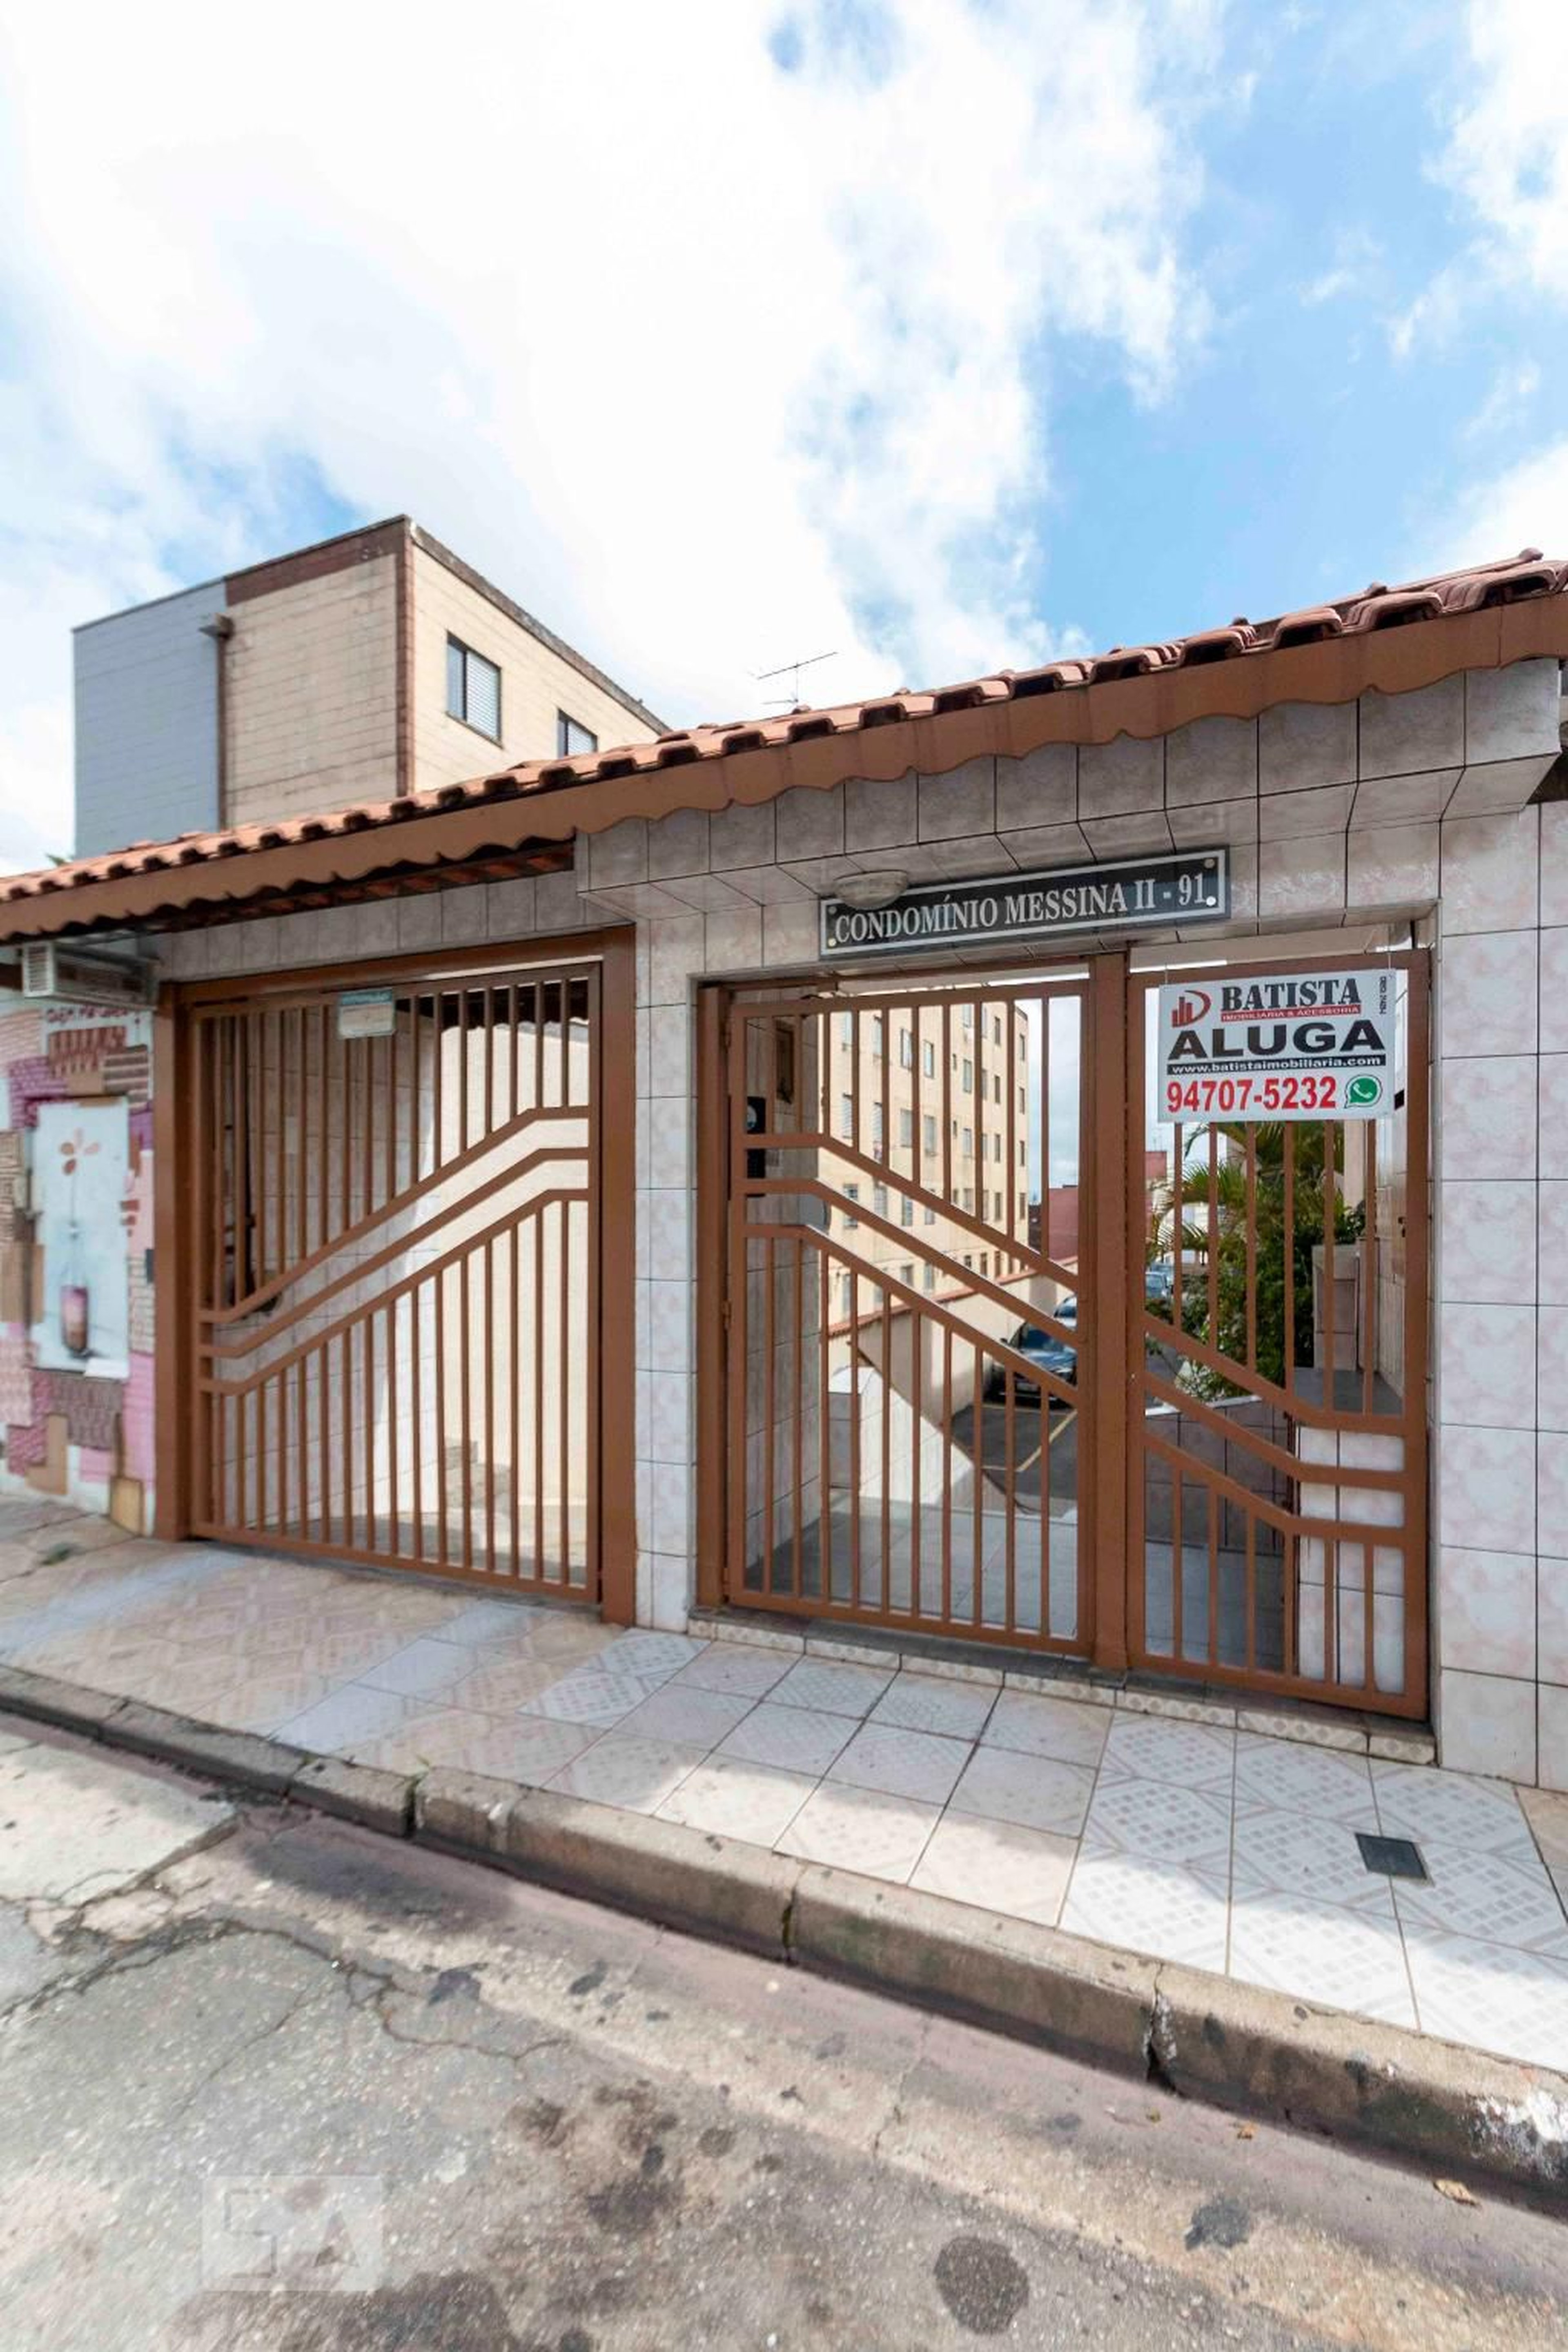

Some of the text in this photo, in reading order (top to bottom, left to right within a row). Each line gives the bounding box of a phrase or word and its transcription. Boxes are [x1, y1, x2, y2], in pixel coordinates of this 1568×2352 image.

[835, 894, 998, 942] CONDOMÍNIO
[1004, 883, 1127, 924] MESSINA
[1135, 879, 1155, 910] II
[1178, 873, 1206, 905] 91
[1221, 978, 1361, 1011] BATISTA
[1168, 1020, 1385, 1060] ALUGA
[1172, 1056, 1381, 1074] www.batistaimobiliaria.com
[1167, 1076, 1336, 1113] 94707-5232
